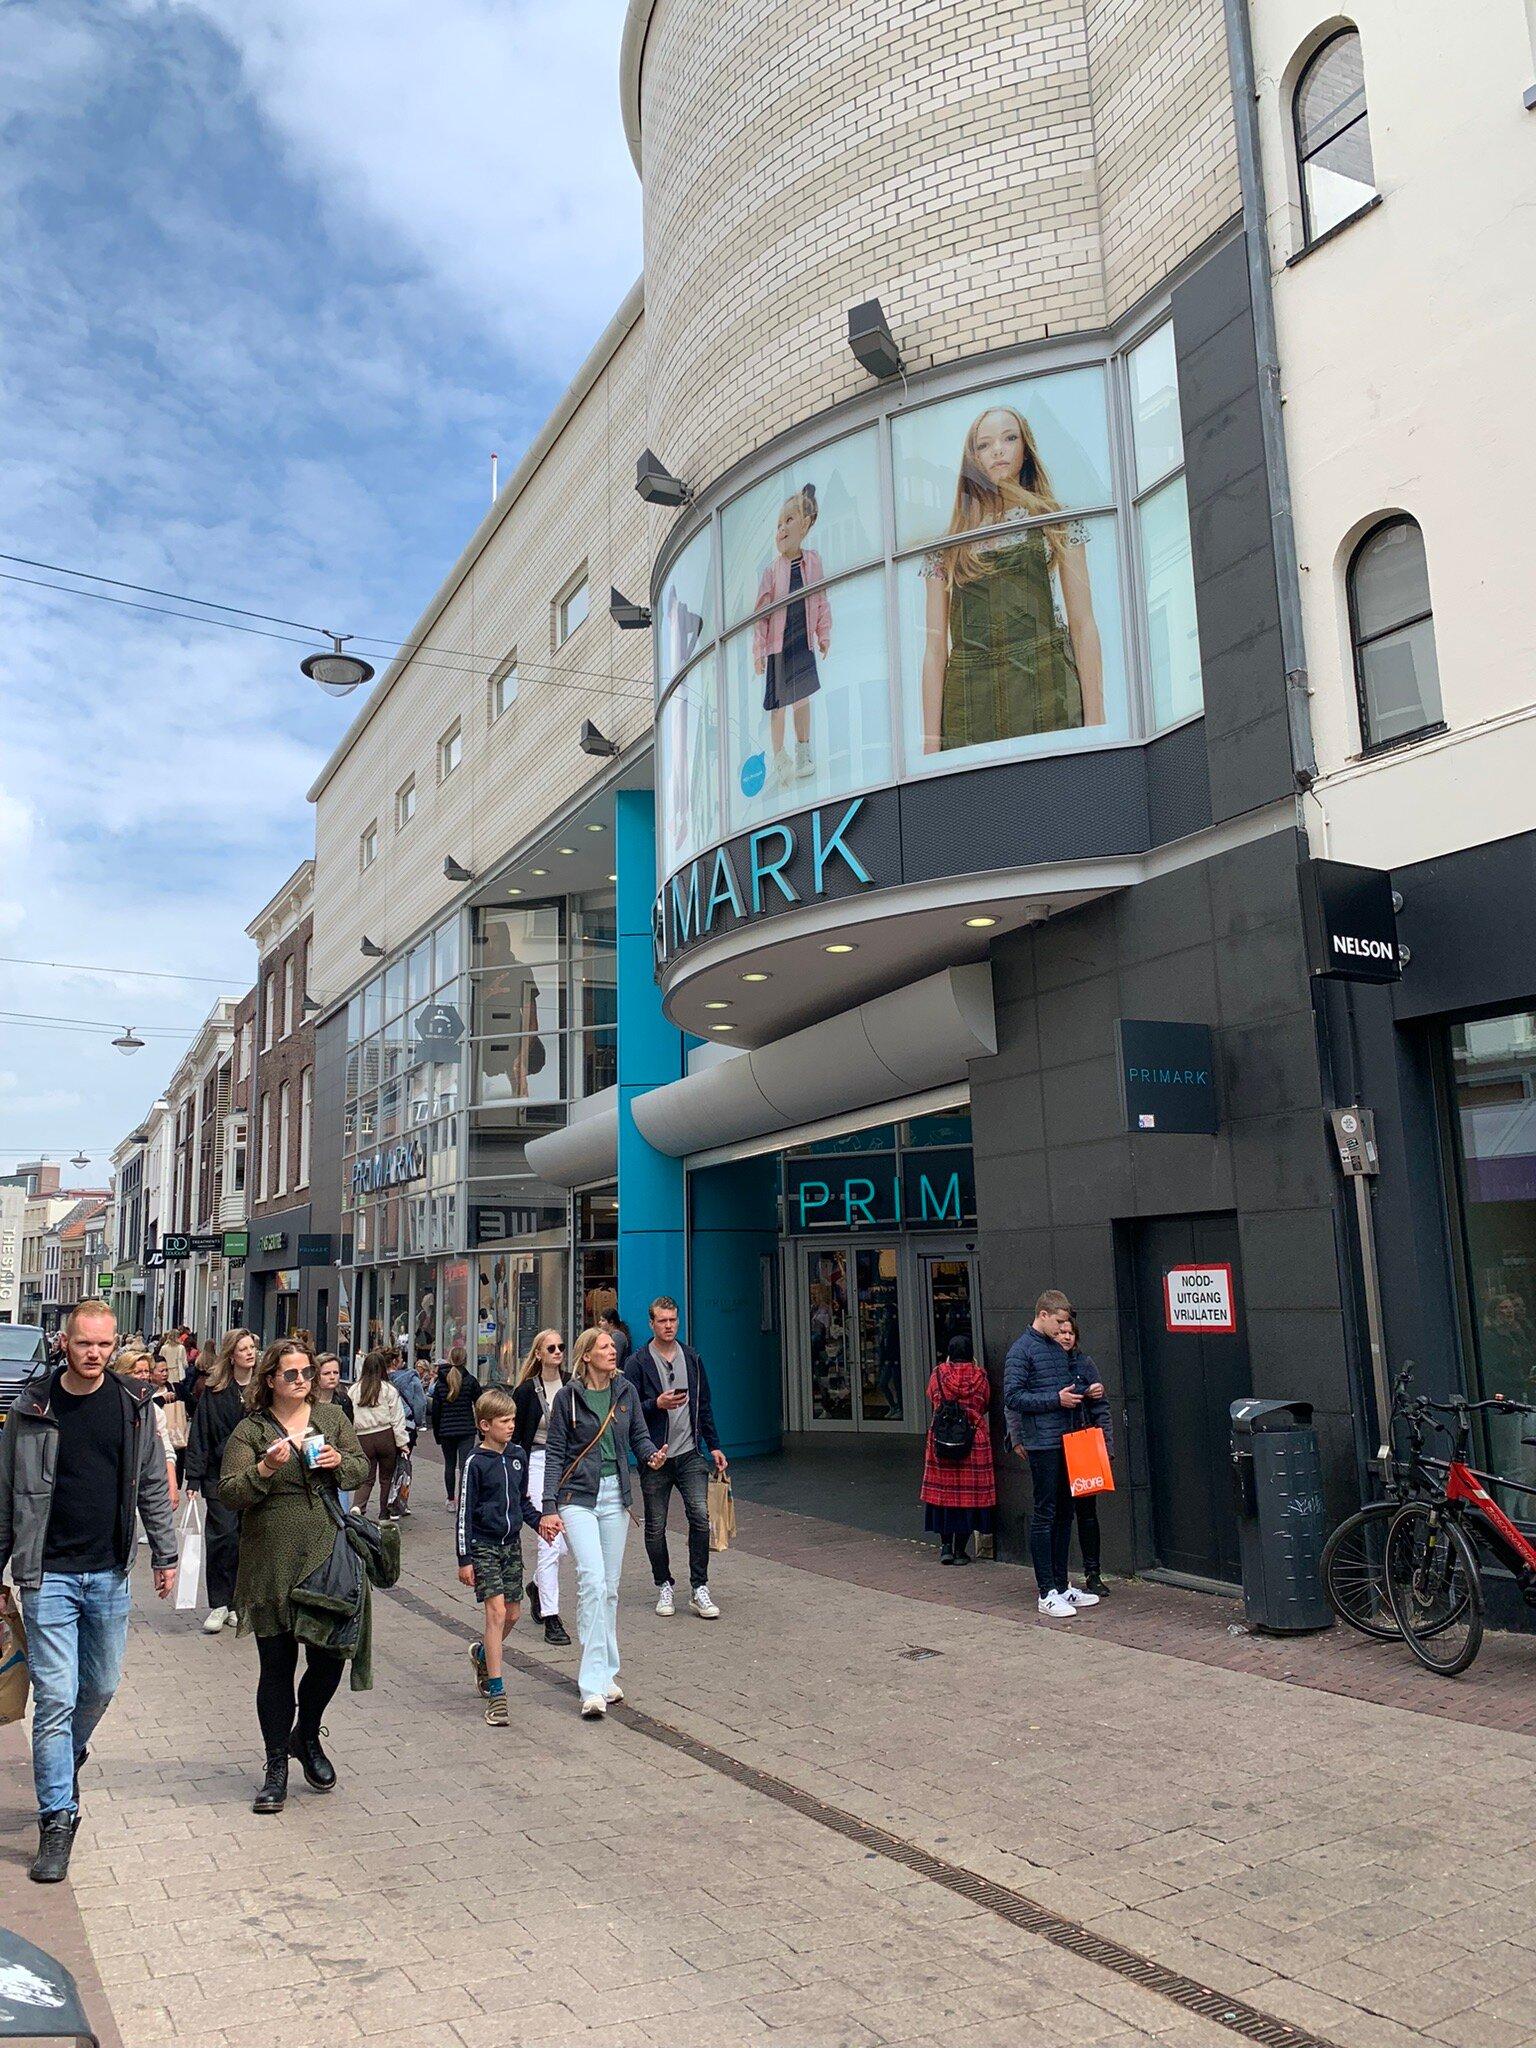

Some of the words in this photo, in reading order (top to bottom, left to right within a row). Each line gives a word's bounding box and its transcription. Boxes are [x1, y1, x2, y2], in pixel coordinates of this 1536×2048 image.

[1333, 934, 1393, 960] NELSON
[1129, 1068, 1207, 1084] PRIMARK
[799, 1172, 961, 1228] PRIM
[147, 1253, 164, 1265] JD
[1182, 1275, 1214, 1287] NOOD-
[1177, 1292, 1222, 1304] UITGANG
[1174, 1309, 1228, 1321] VRIJLATEN
